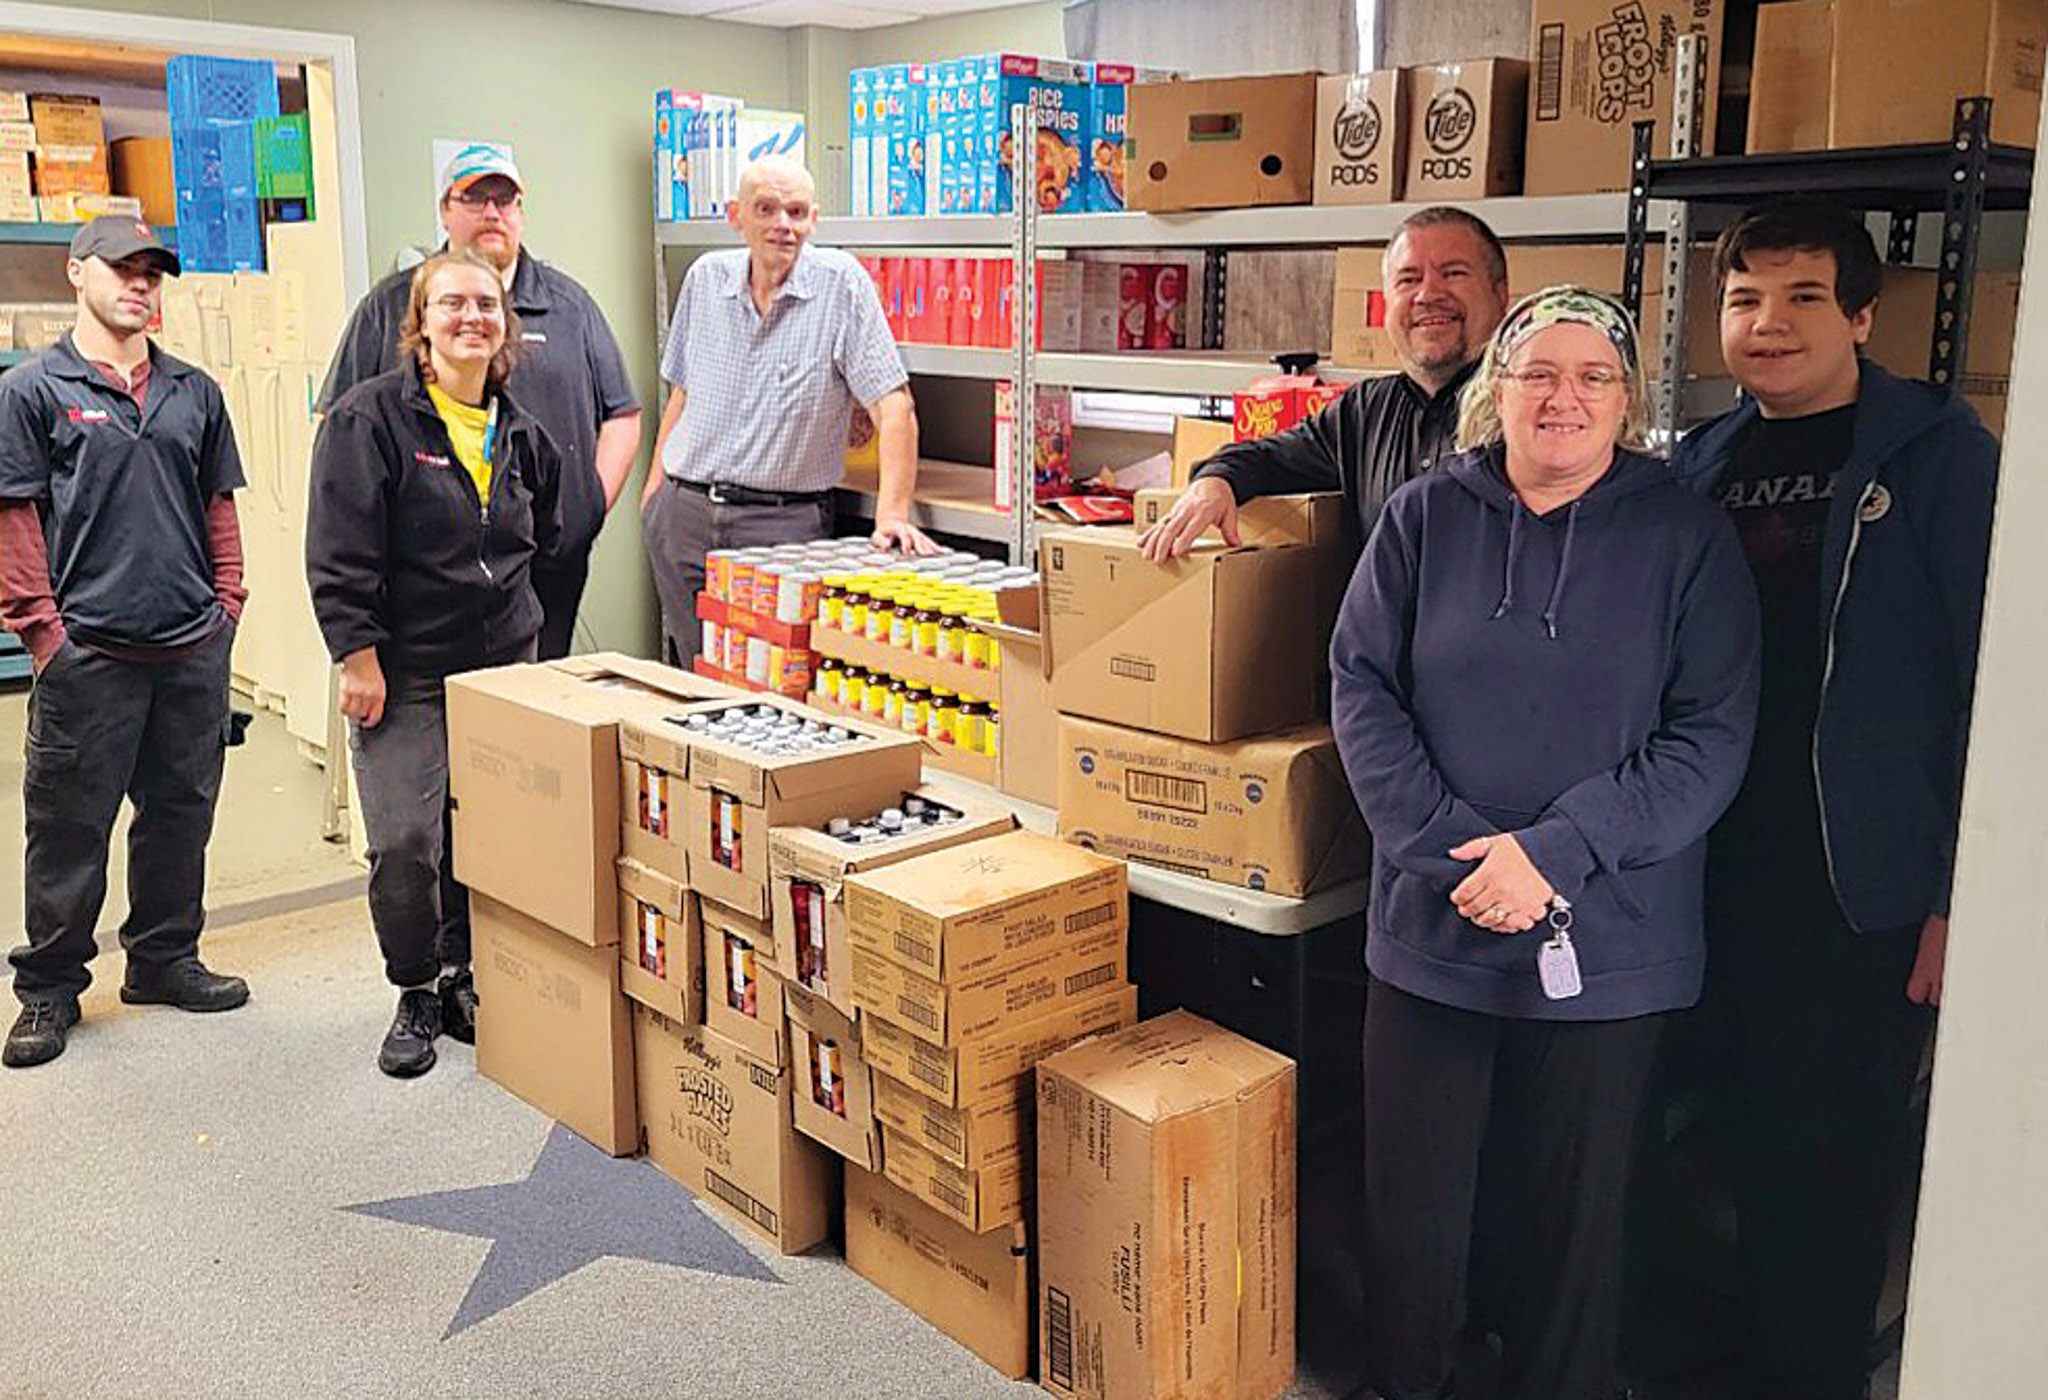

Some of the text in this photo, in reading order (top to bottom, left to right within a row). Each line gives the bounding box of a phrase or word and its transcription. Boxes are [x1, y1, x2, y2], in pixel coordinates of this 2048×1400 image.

[1596, 23, 1627, 123] LOOPS
[1612, 1, 1654, 109] FROOT
[1337, 111, 1376, 150] Tide
[1428, 101, 1471, 144] Tide
[1331, 163, 1379, 187] PODS
[1421, 157, 1472, 181] PODS
[1718, 471, 1838, 509] ANA
